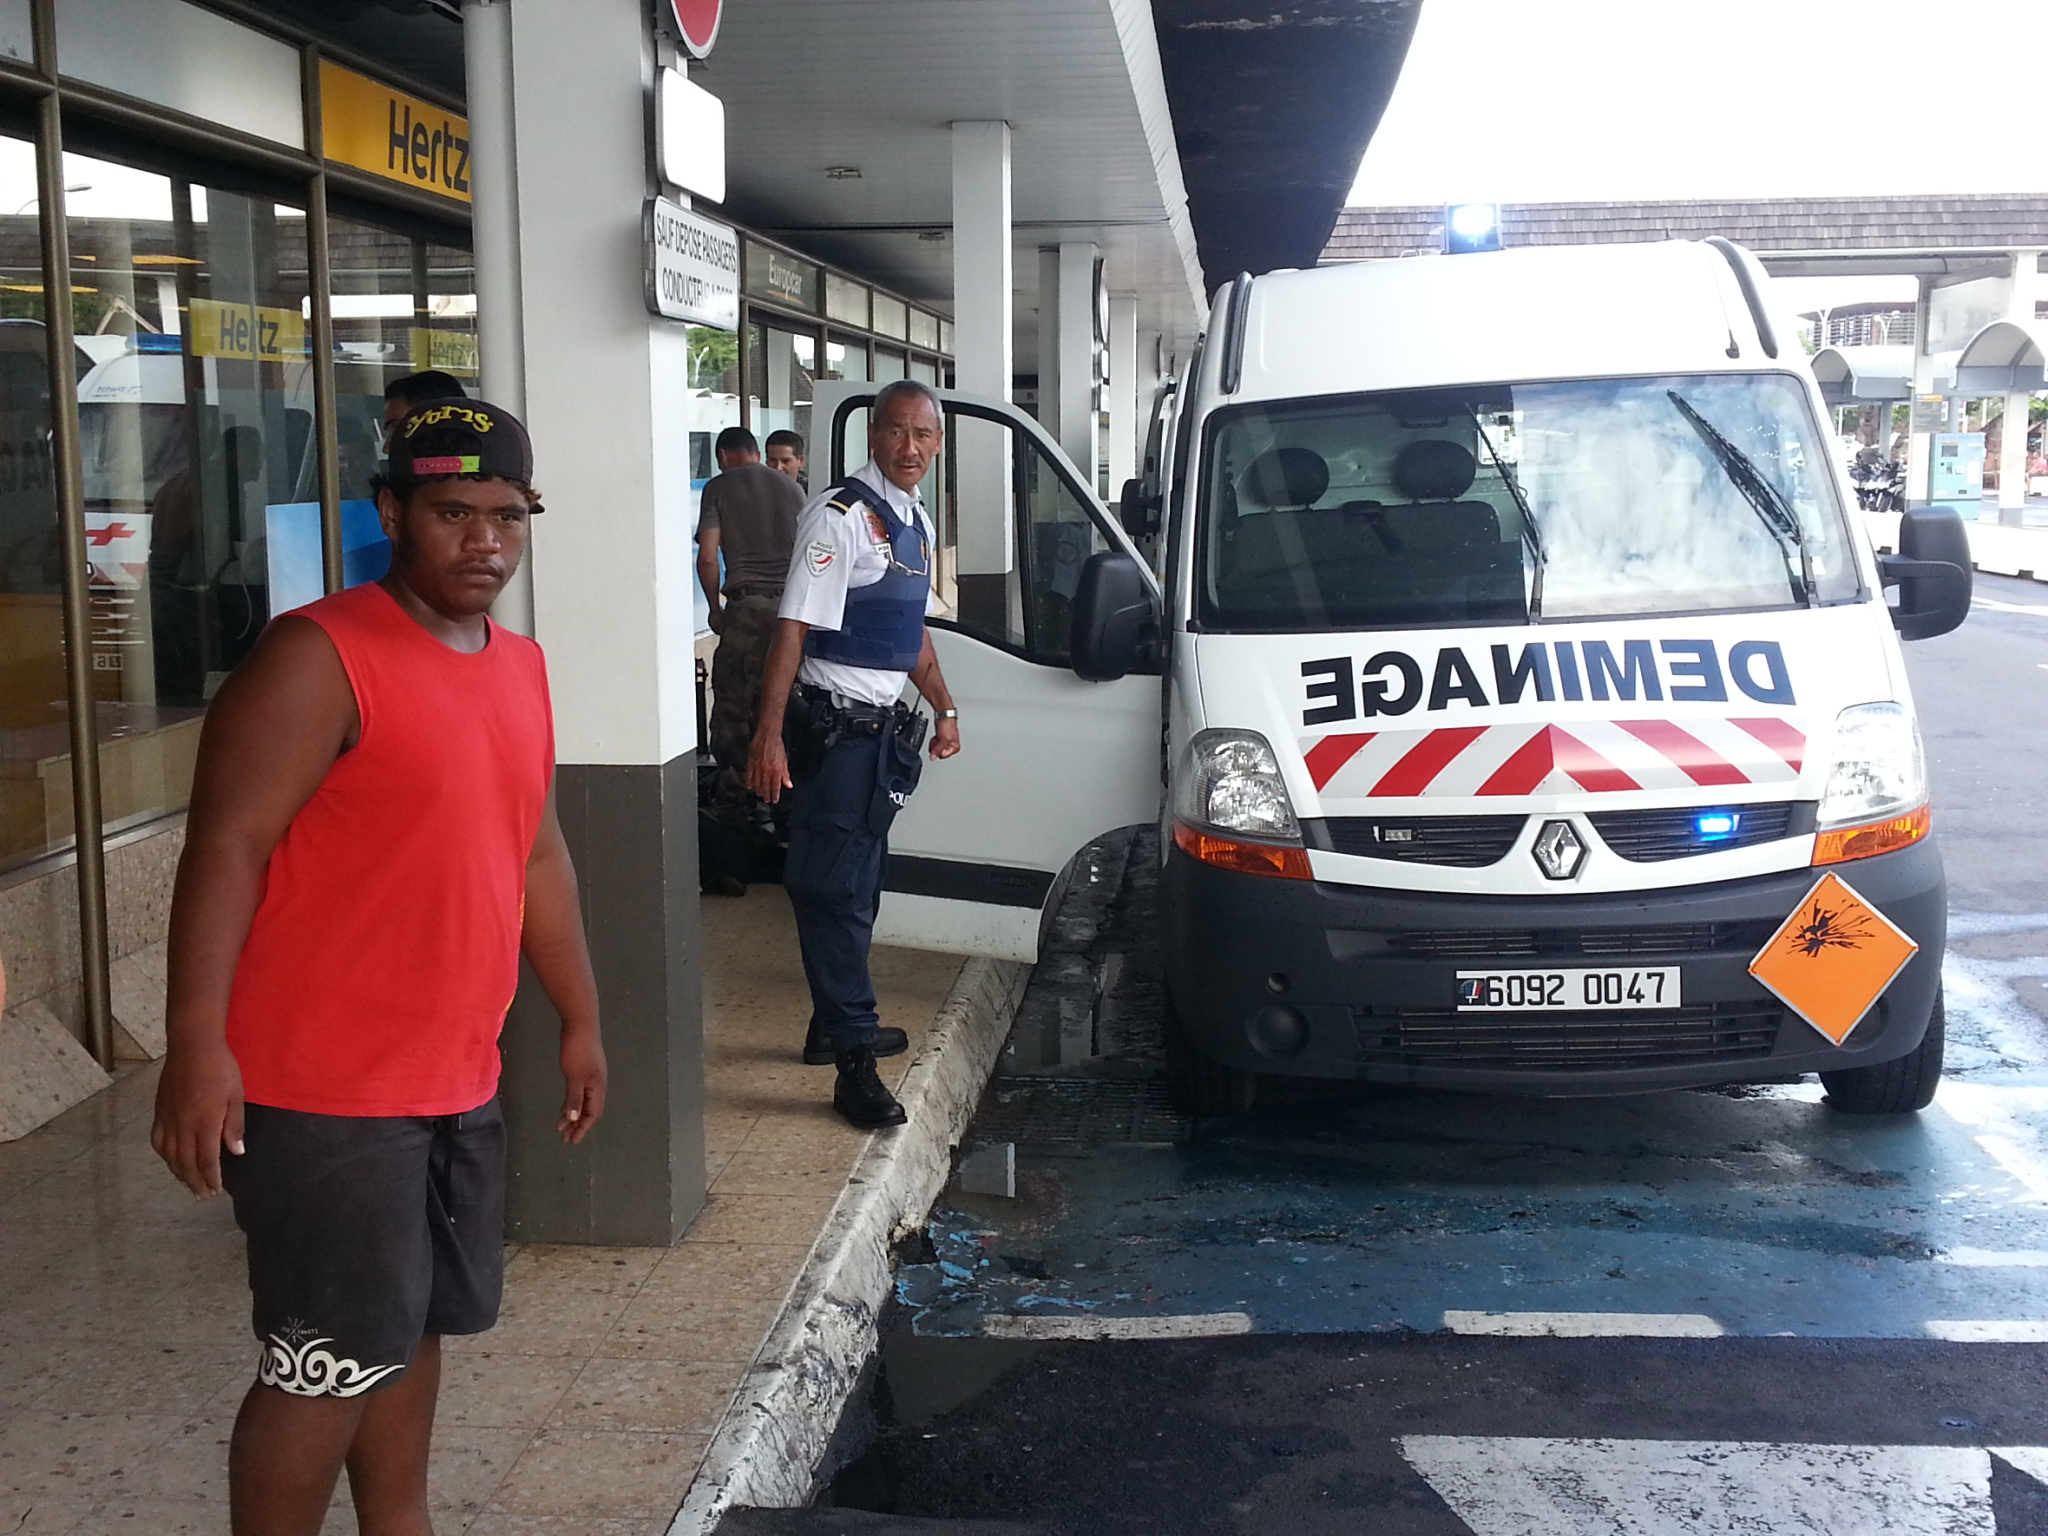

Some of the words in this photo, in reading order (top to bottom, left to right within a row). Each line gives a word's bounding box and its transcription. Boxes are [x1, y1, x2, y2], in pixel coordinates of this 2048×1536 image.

[388, 99, 469, 193] Hertz
[657, 212, 674, 249] SAUF
[676, 220, 701, 260] DEPOSE
[702, 231, 736, 273] PASSAGERS
[769, 254, 802, 300] Europcar
[220, 309, 279, 354] Hertz
[1485, 975, 1566, 1006] 6092
[1583, 972, 1665, 1004] 0047
